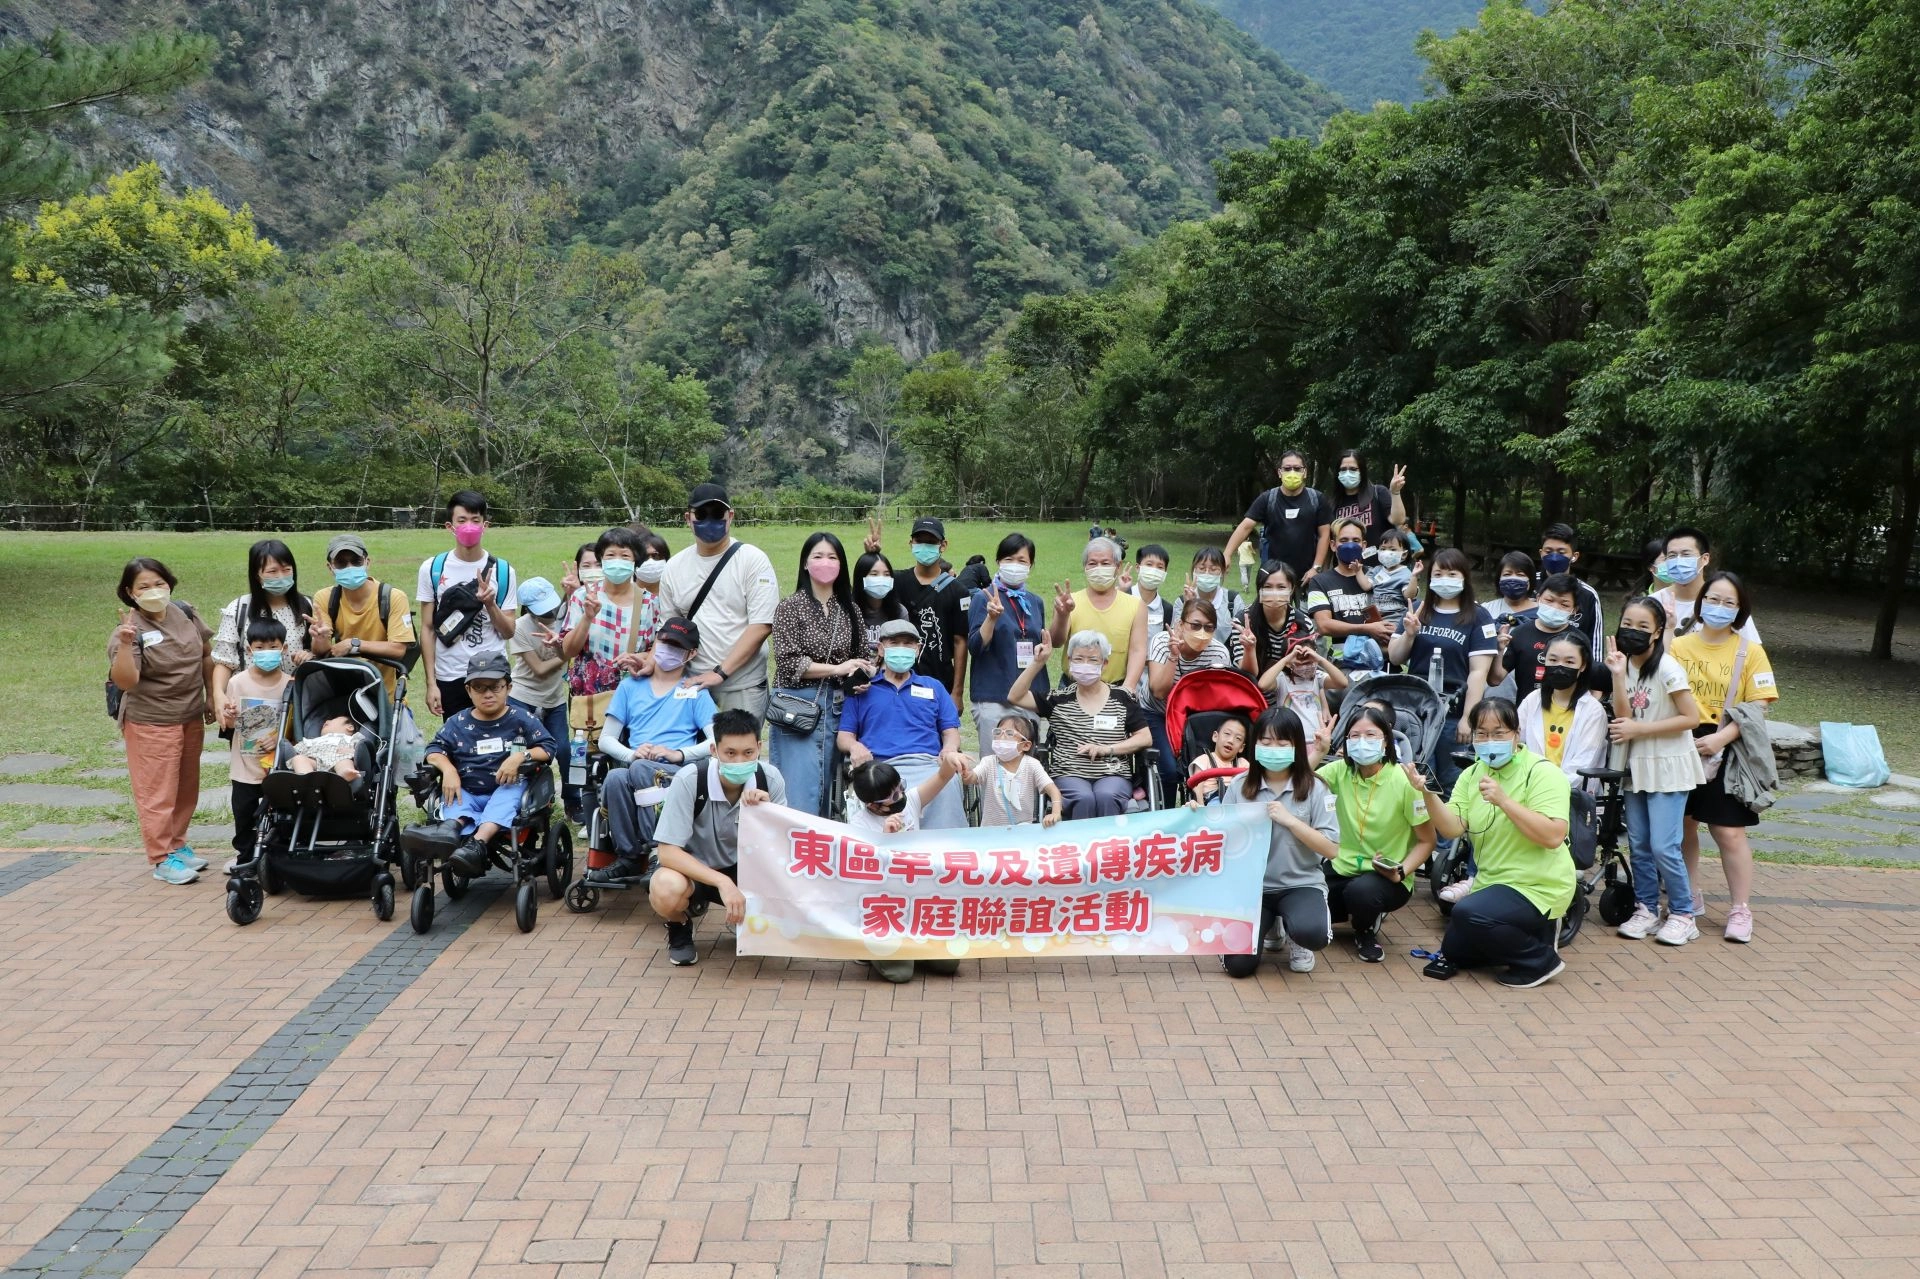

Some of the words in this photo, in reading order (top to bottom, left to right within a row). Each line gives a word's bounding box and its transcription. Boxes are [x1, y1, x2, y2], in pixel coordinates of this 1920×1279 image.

[1417, 625, 1467, 646] LIFORNIA
[1682, 659, 1710, 677] TART
[789, 829, 1225, 886] 東區罕見及遺傳疾病
[862, 890, 1152, 938] 家庭聯誼活動
